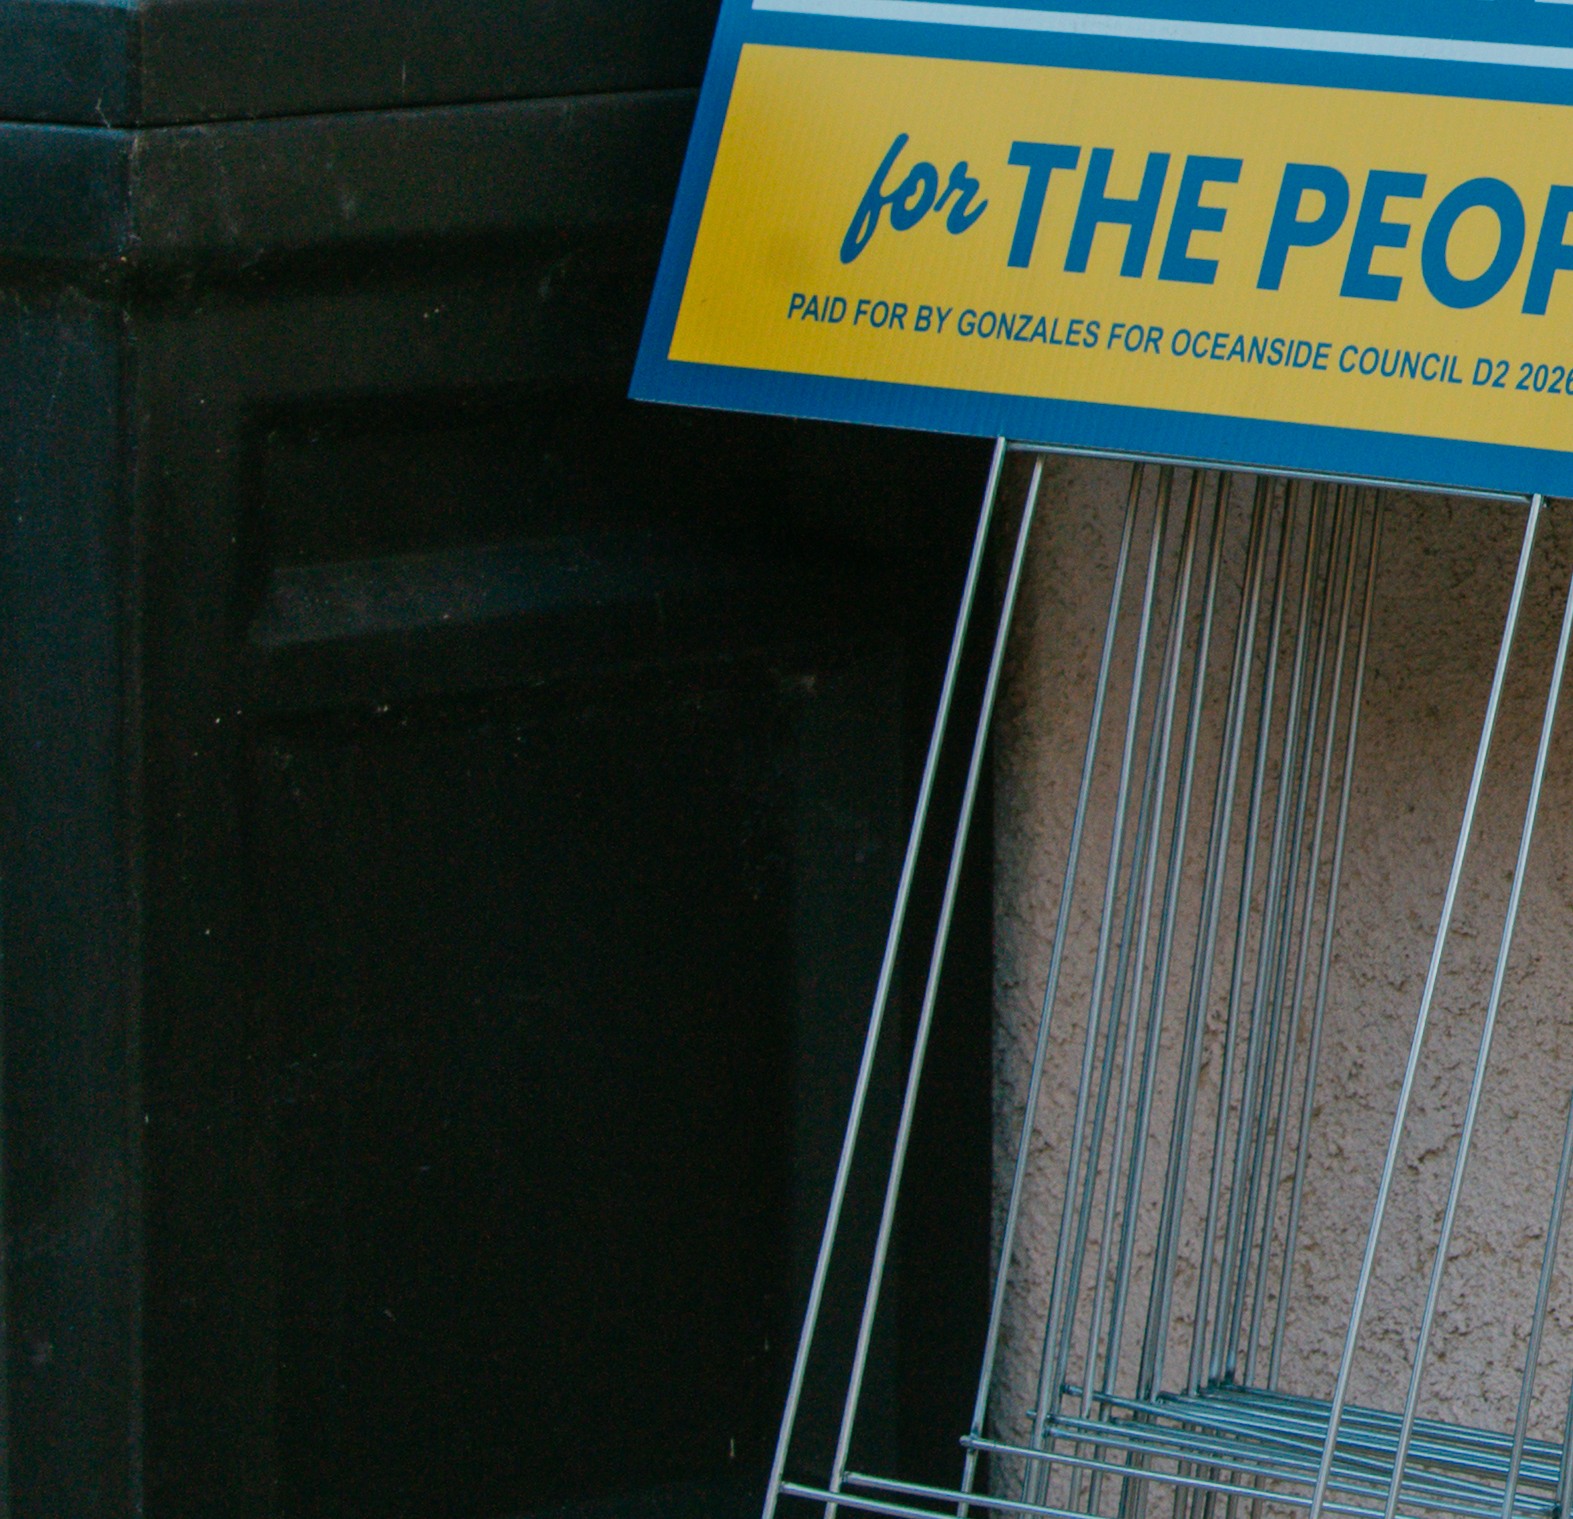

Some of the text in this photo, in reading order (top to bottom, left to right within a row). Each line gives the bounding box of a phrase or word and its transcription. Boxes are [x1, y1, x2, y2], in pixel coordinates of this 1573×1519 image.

[839, 132, 989, 265] for
[1006, 140, 1244, 285] THE
[787, 293, 847, 323] PAID
[853, 299, 908, 330] FOR
[913, 304, 953, 333] BY
[957, 308, 1101, 349] GONZALES
[1106, 322, 1164, 355] FOR
[1170, 328, 1333, 371] OCEANSIDE
[1338, 344, 1463, 384] COUNCIL
[1471, 357, 1510, 389] D2
